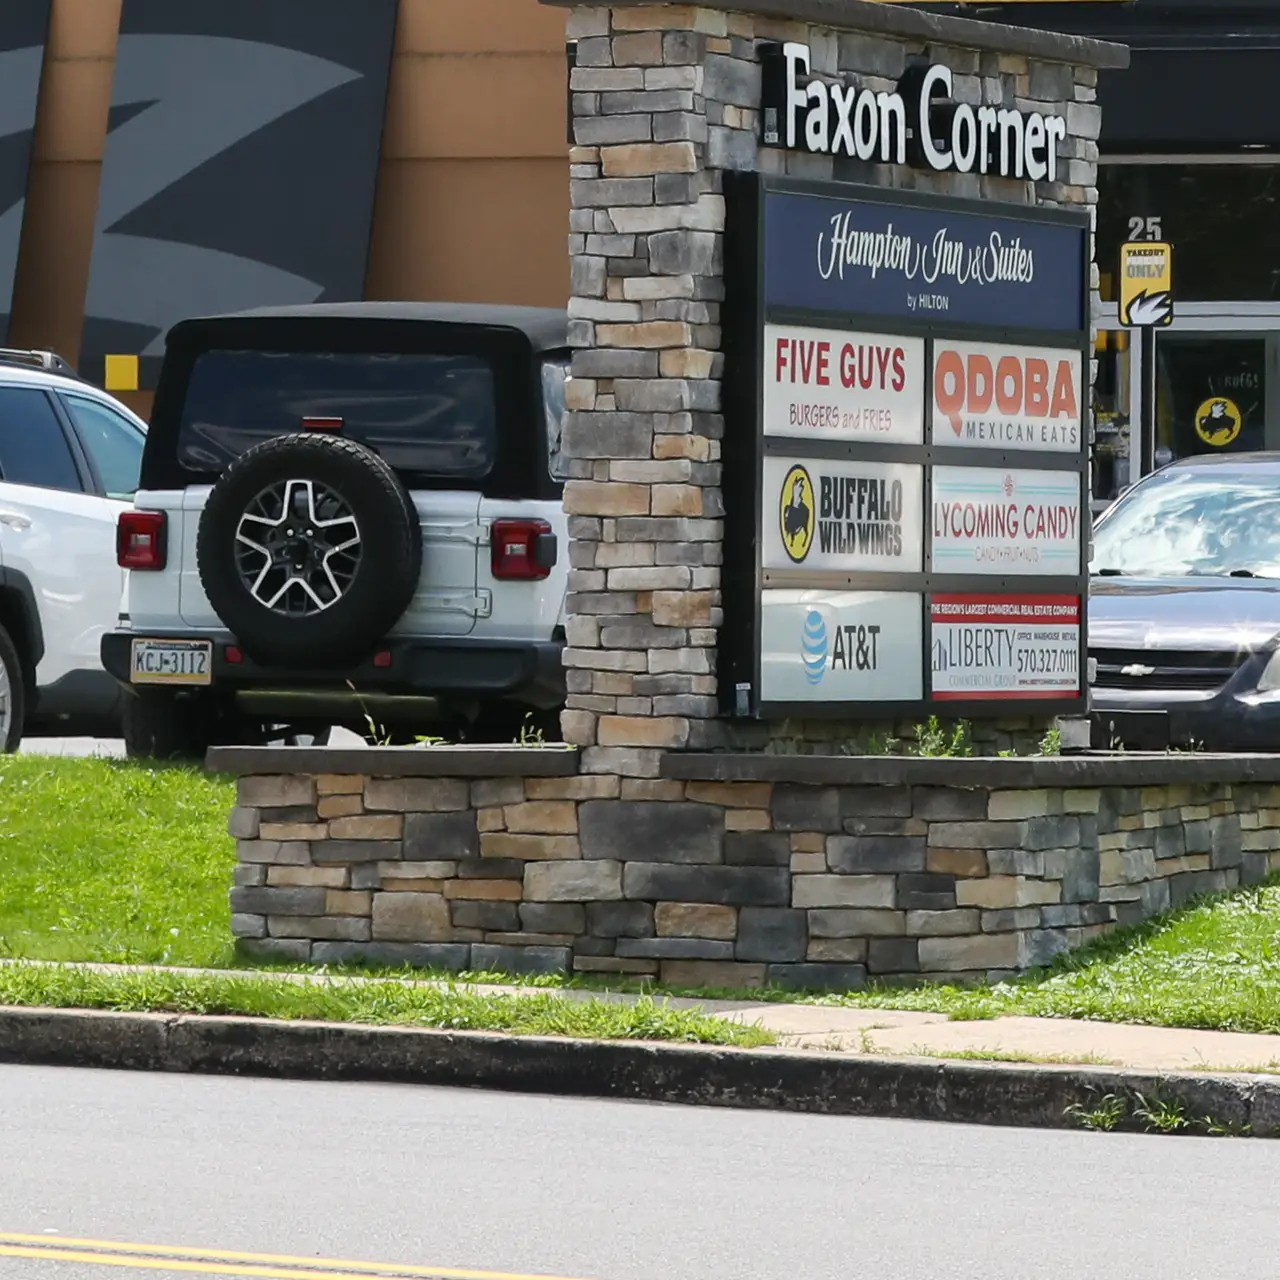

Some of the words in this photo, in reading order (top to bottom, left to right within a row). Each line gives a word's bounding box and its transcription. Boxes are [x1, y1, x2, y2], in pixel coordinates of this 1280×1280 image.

[782, 41, 907, 165] Faxon
[919, 64, 1066, 183] Corner
[817, 210, 920, 281] Hampton
[921, 227, 972, 284] Inn
[982, 231, 1034, 283] Suites
[1127, 216, 1162, 241] 25
[1126, 248, 1165, 257] TAKEOUT
[1126, 264, 1165, 278] ONLY
[907, 292, 917, 312] by
[918, 293, 949, 310] HILTON
[776, 337, 831, 386] FIVE
[839, 342, 906, 392] GUYS
[934, 349, 1079, 438] QDOBA
[789, 403, 840, 429] BURGERS
[842, 408, 860, 429] and
[862, 409, 892, 432] FRIES
[966, 422, 1034, 442] MEXICAN
[1041, 426, 1078, 445] EATS
[819, 475, 903, 523] BUFFALO
[818, 520, 856, 555] WILD
[856, 521, 903, 557] WINGS
[934, 502, 1019, 539] LYCOMING
[1023, 504, 1078, 540] CANDY
[965, 604, 987, 615] LARGEST
[987, 604, 1020, 615] COMMERCIAL
[1021, 605, 1034, 616] REAL
[1034, 605, 1052, 616] ESTATE
[1053, 605, 1078, 616] COMPANY
[831, 624, 881, 671] AT&T
[948, 627, 1016, 668] LIBERTY
[1017, 648, 1077, 673] 570.327.0111
